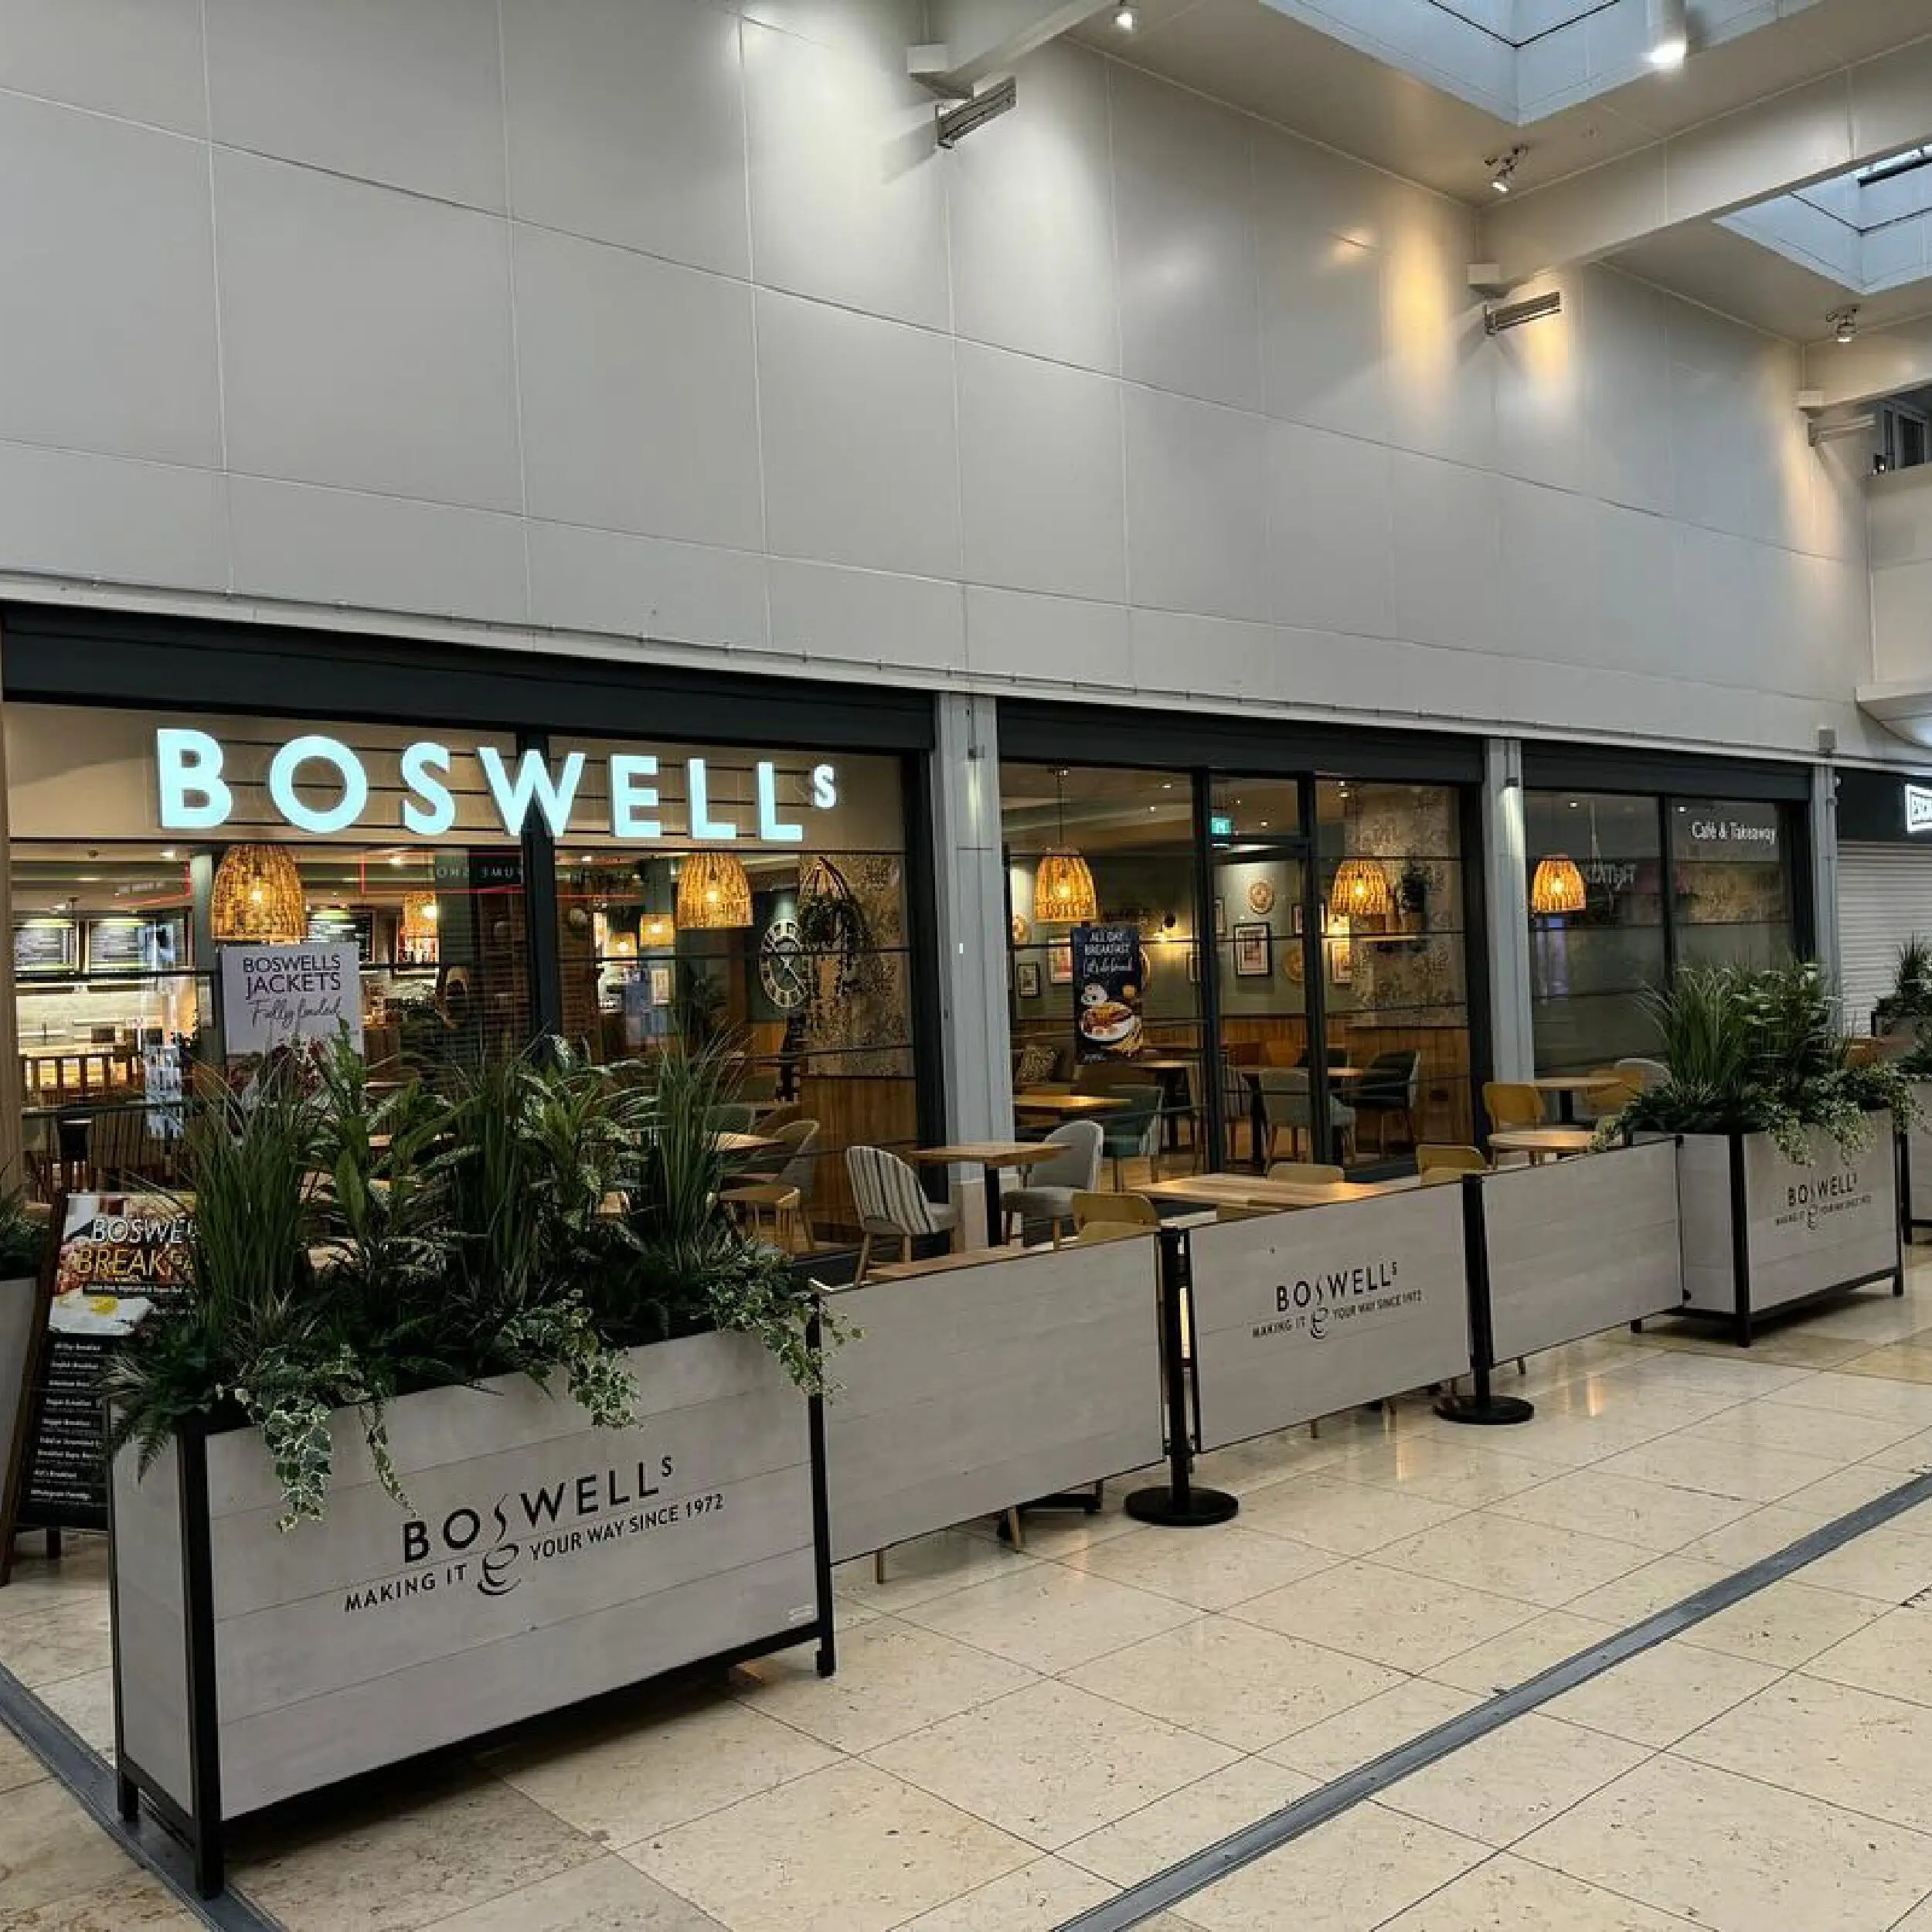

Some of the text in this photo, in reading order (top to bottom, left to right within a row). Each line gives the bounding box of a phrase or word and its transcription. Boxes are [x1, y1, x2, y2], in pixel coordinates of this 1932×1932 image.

[157, 728, 838, 842] BOSWELLS
[243, 954, 341, 973] BOSWELLS
[245, 971, 341, 1001] JACKETS
[93, 1219, 196, 1243] BOSWEL
[1276, 1261, 1397, 1312] BOSWELLS
[402, 1454, 674, 1563] BOSWELLS
[344, 1492, 724, 1613] MAKING IT YOUR WAY SINCE 1972
